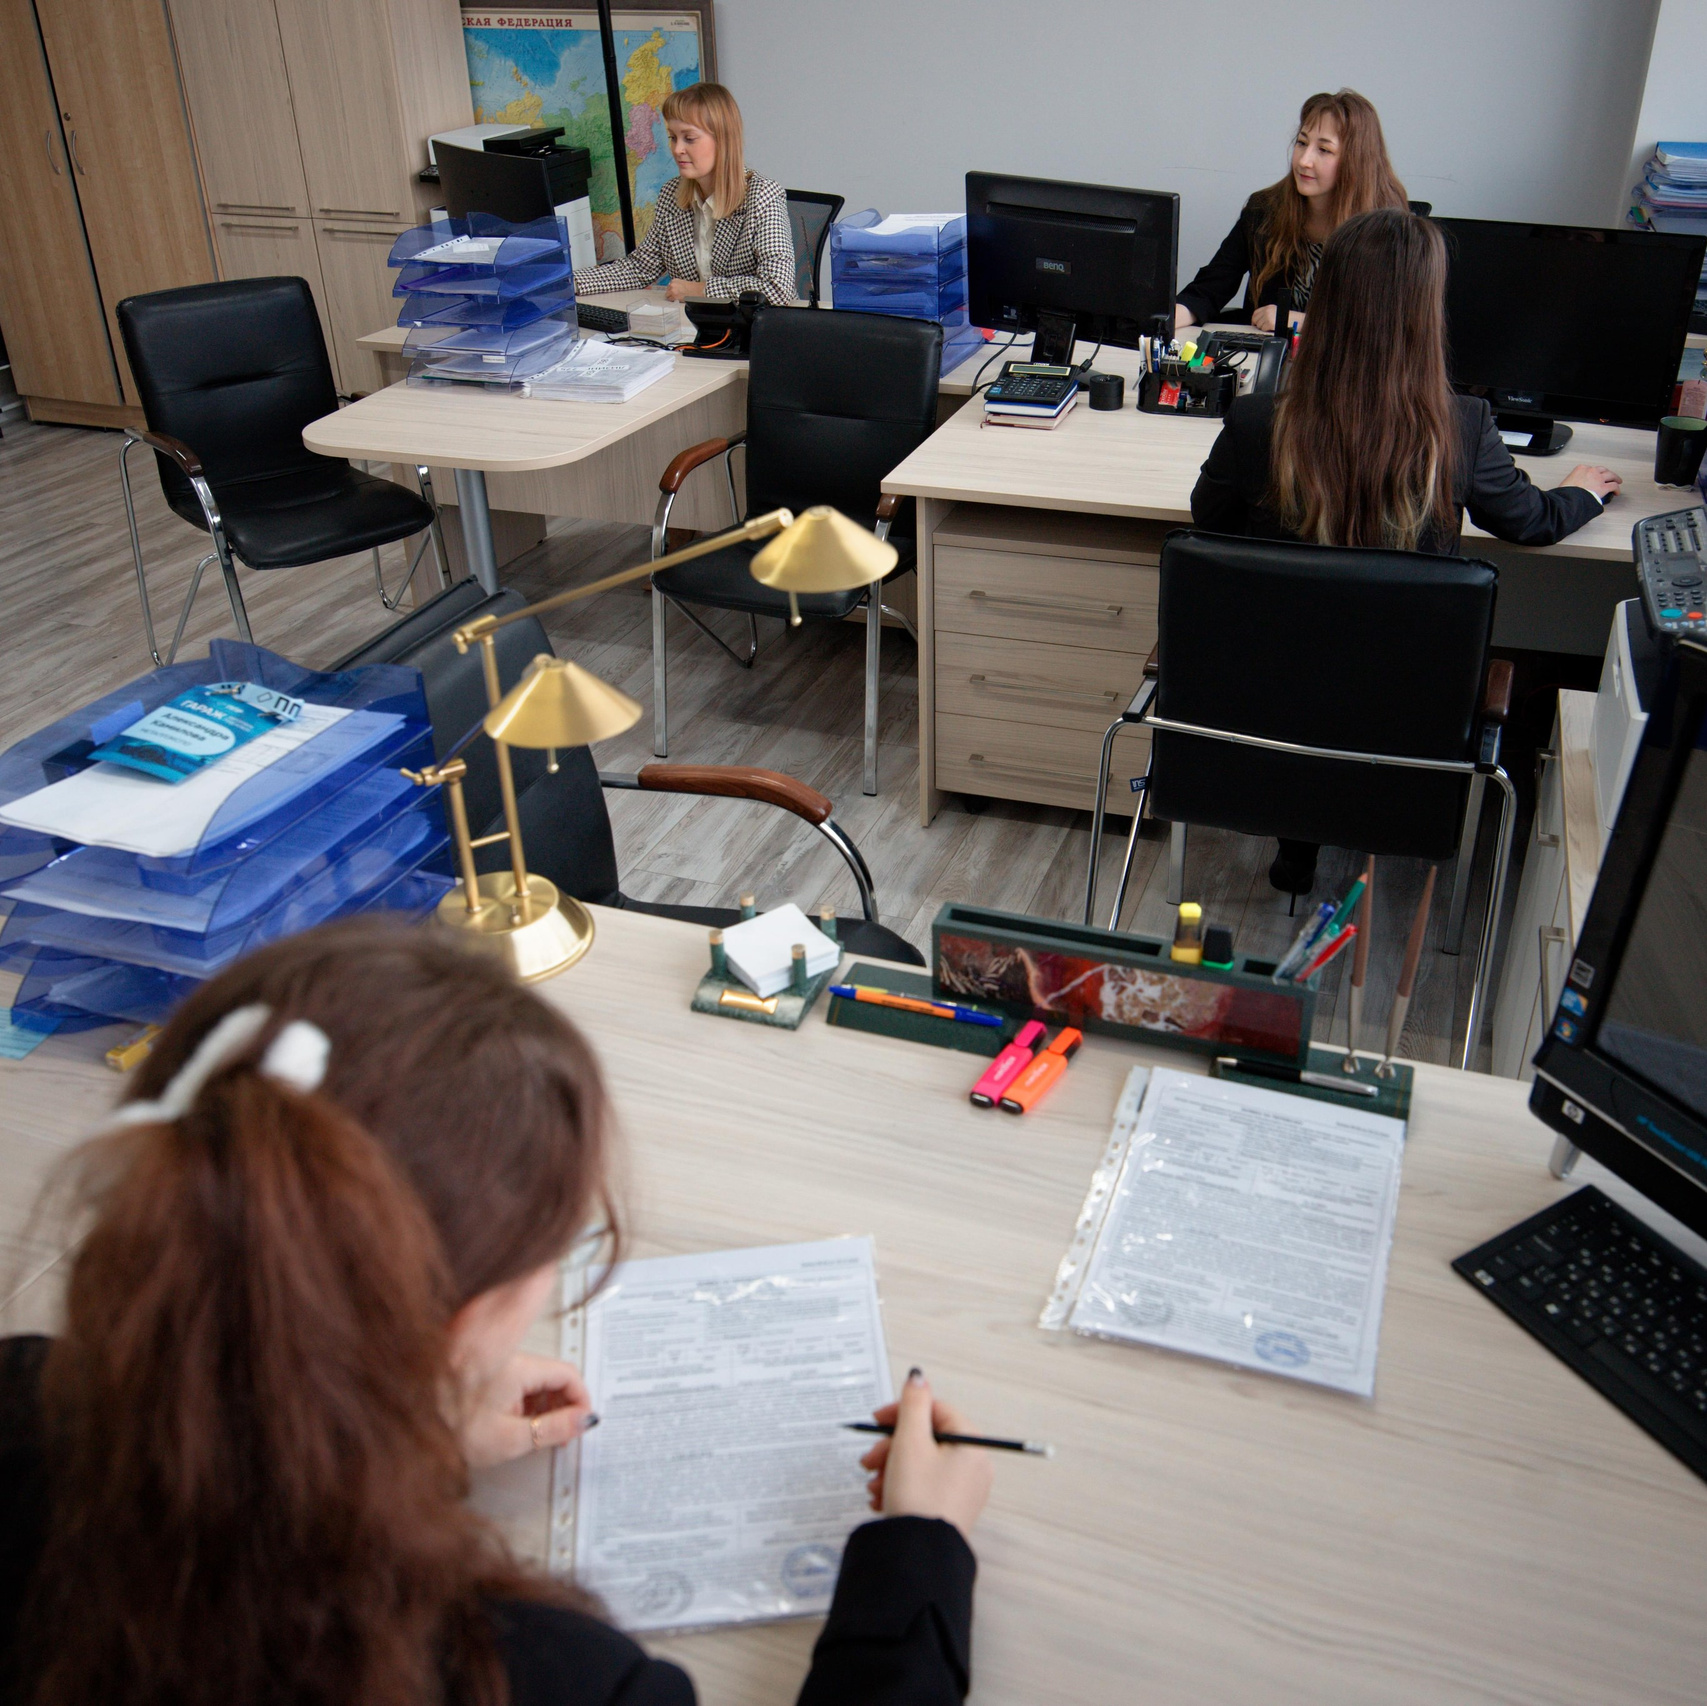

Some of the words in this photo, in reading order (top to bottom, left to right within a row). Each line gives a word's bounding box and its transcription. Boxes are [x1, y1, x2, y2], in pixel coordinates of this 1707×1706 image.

[497, 18, 573, 28] ФЕДЕРАЦИЯ
[180, 700, 227, 720] ГАРАЖ
[162, 713, 230, 741] Александра
